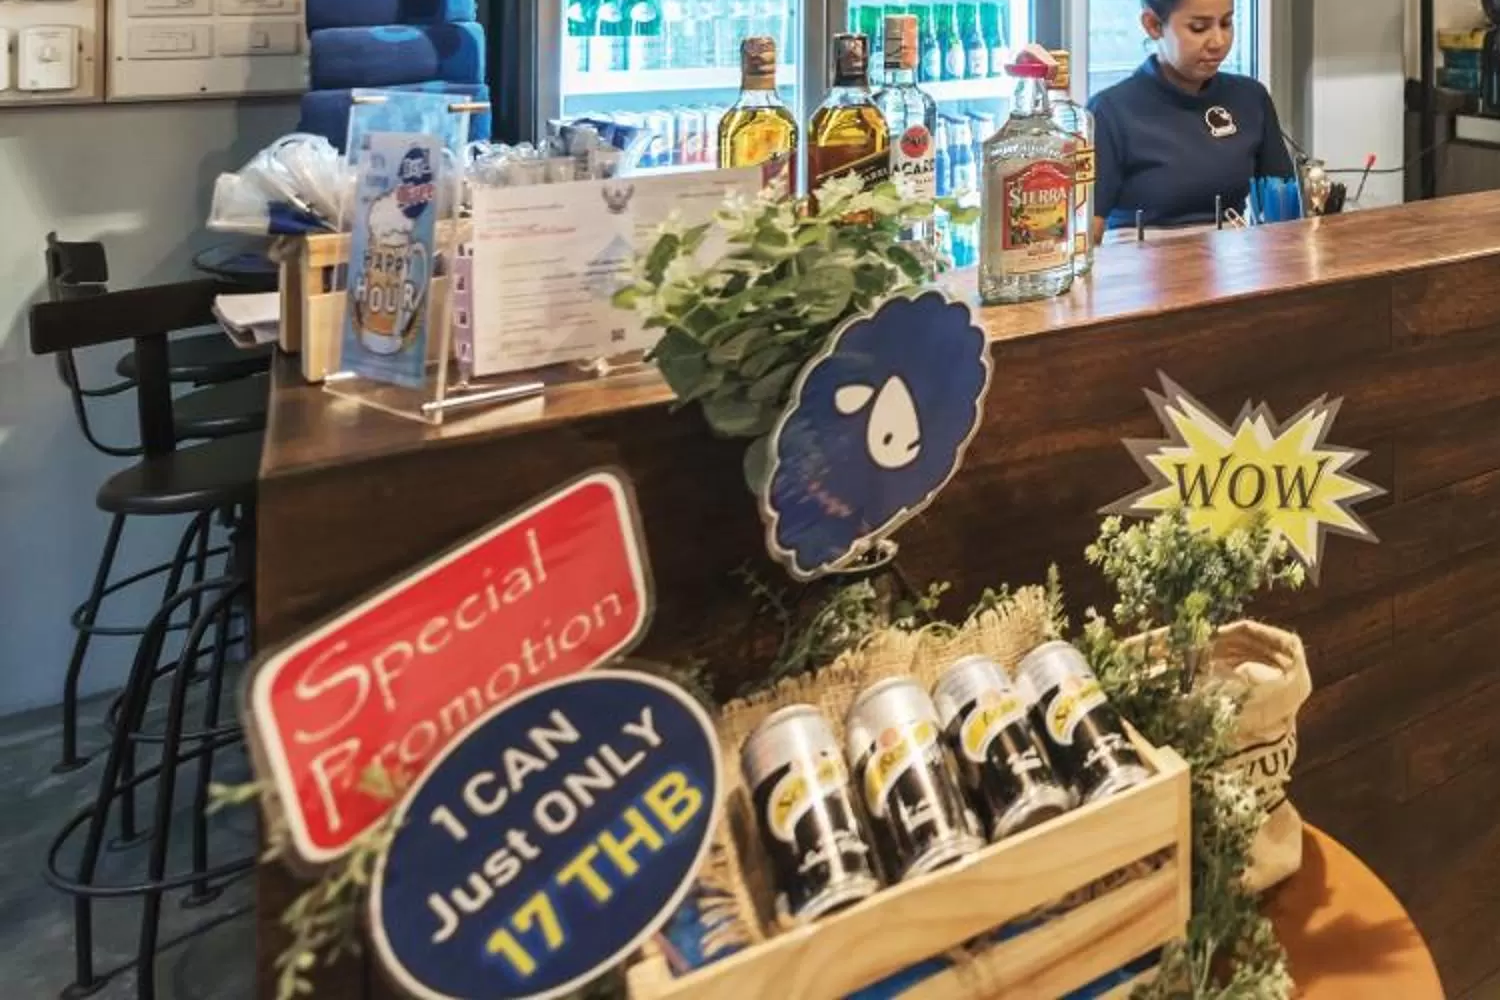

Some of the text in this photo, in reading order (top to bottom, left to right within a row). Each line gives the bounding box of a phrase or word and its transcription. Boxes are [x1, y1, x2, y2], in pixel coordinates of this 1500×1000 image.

[1009, 186, 1067, 204] SIERRA
[354, 275, 418, 313] HOUR
[1172, 452, 1330, 510] WOW
[294, 527, 548, 747] Special
[309, 592, 623, 832] Promotion
[430, 708, 582, 841] 1 CAN
[430, 706, 665, 943] Just ONLY
[485, 770, 705, 979] 17 THB
